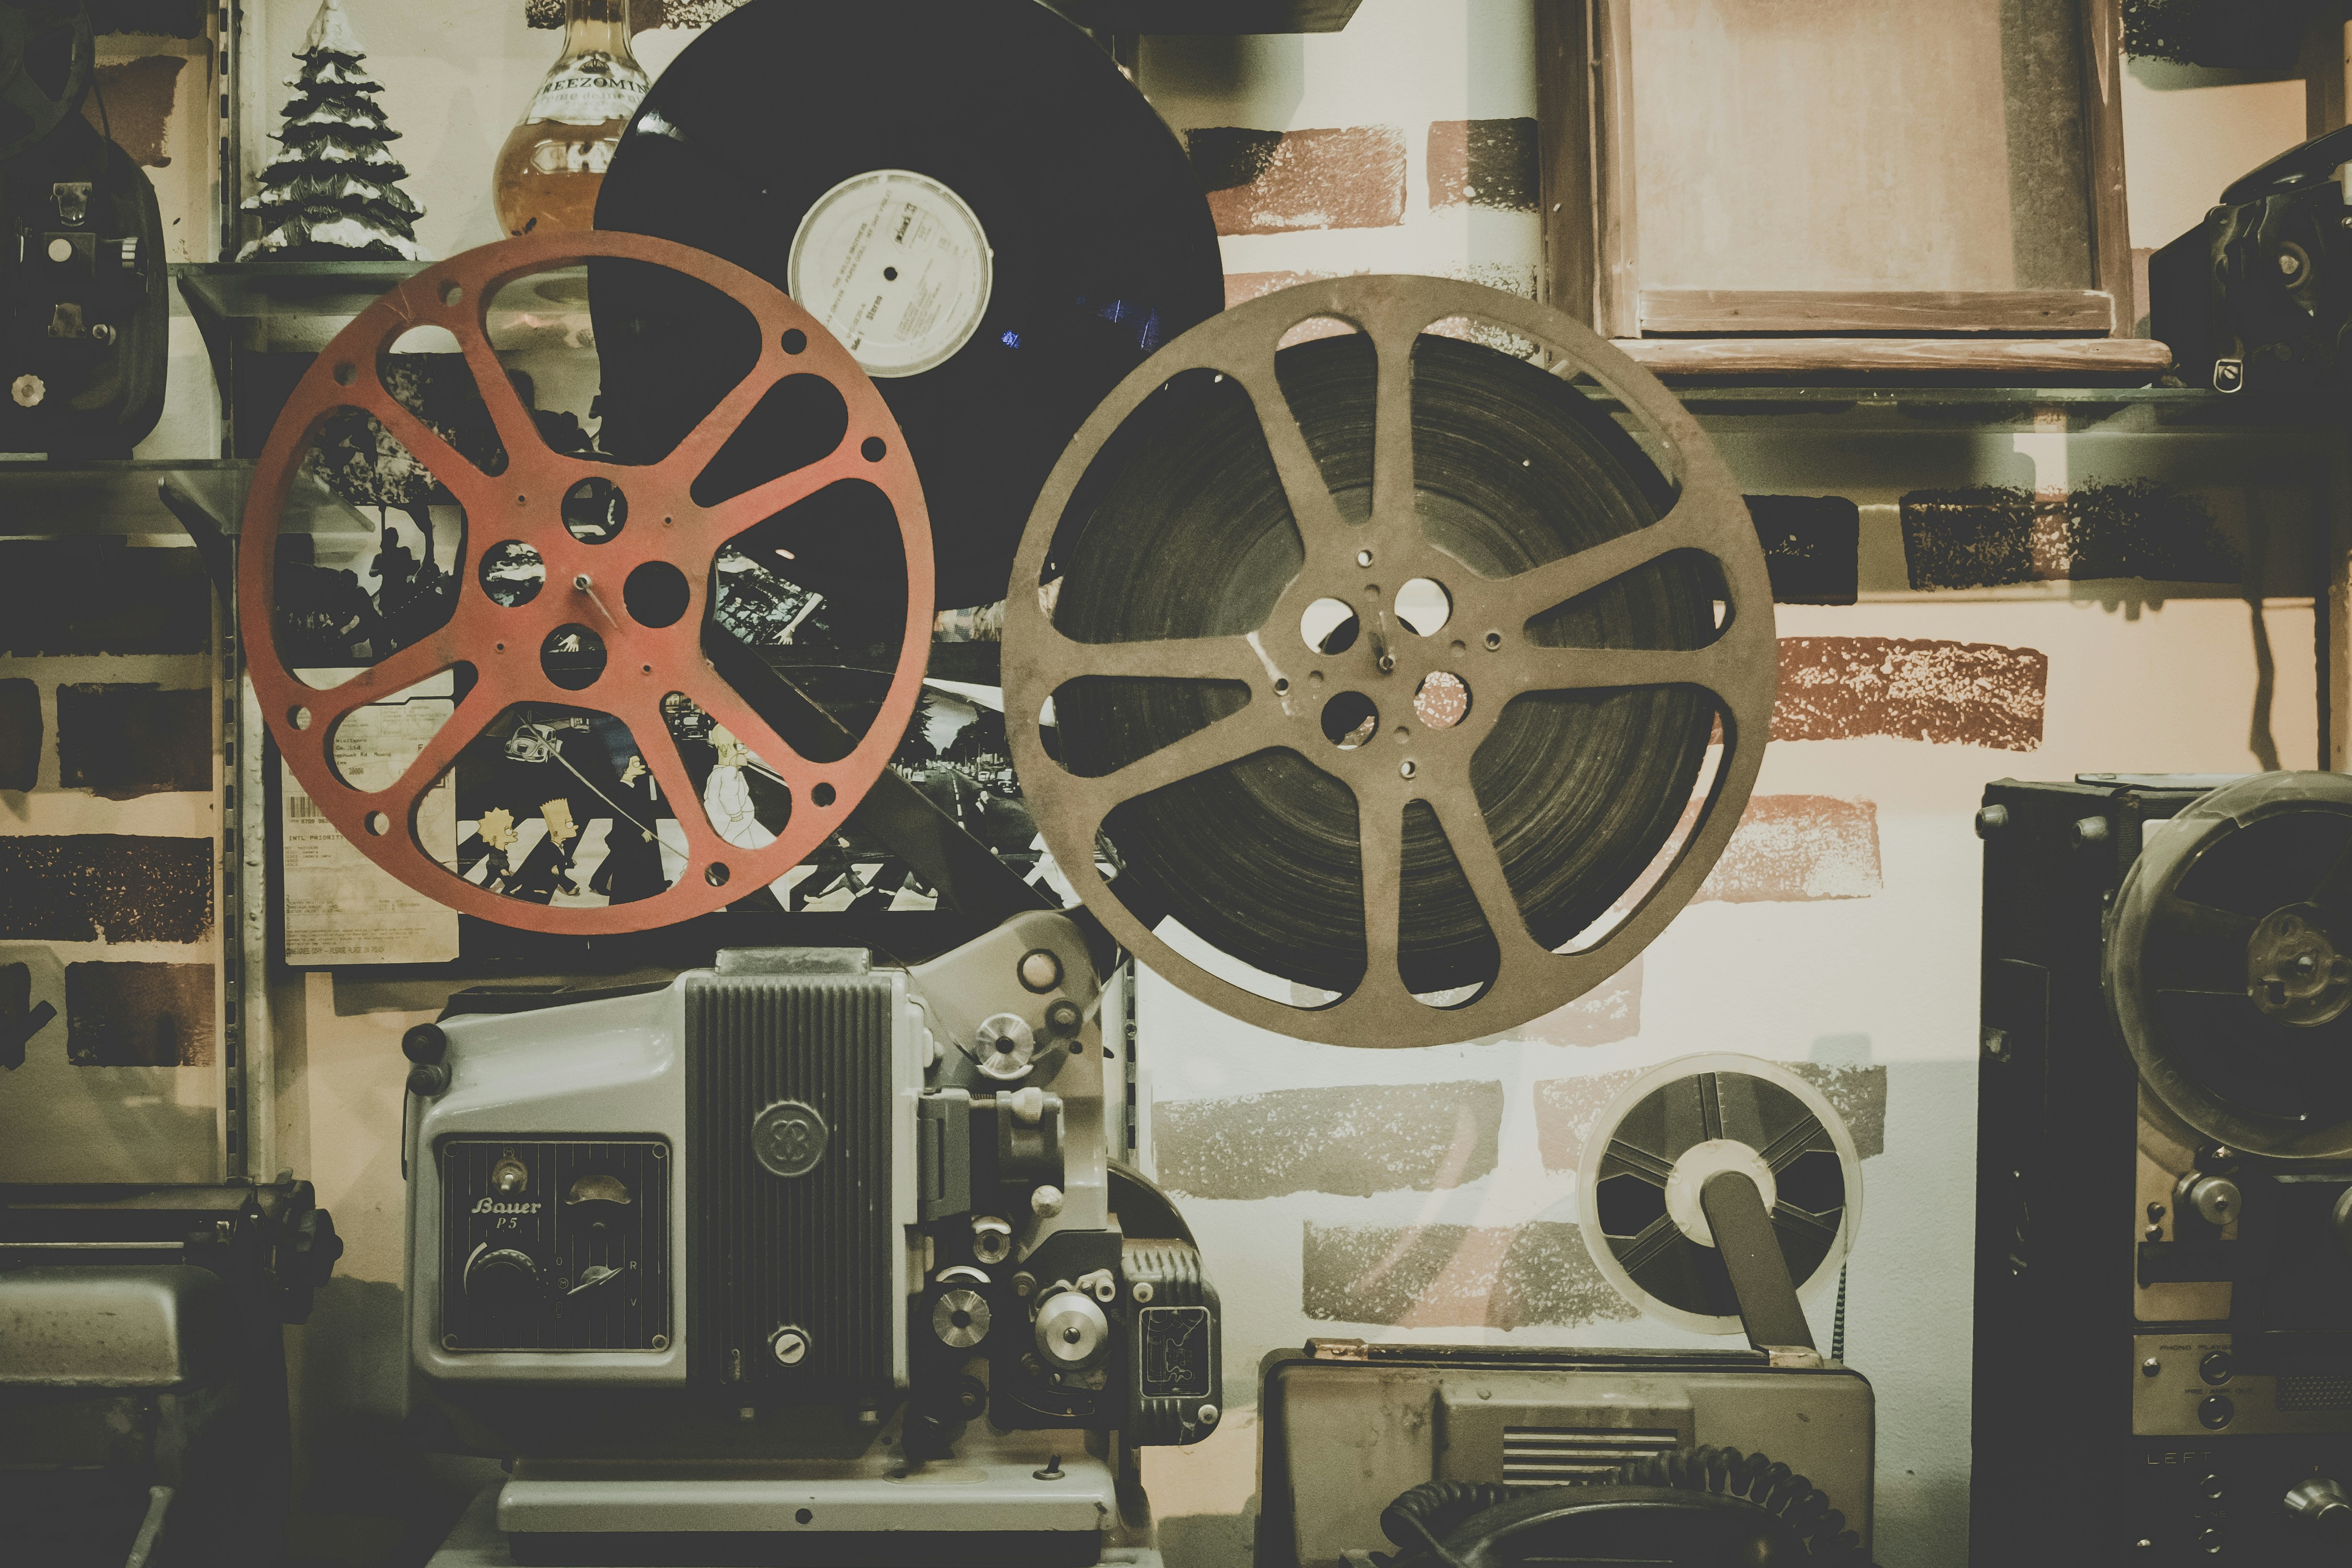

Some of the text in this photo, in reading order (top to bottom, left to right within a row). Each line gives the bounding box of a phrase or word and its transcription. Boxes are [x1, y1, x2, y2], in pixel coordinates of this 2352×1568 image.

[866, 295, 882, 320] Stereo
[471, 1197, 542, 1214] Bauer
[630, 1261, 637, 1271] R
[630, 1298, 637, 1307] V
[2147, 1451, 2212, 1465] LEFT
[2194, 1510, 2227, 1519] LINE
